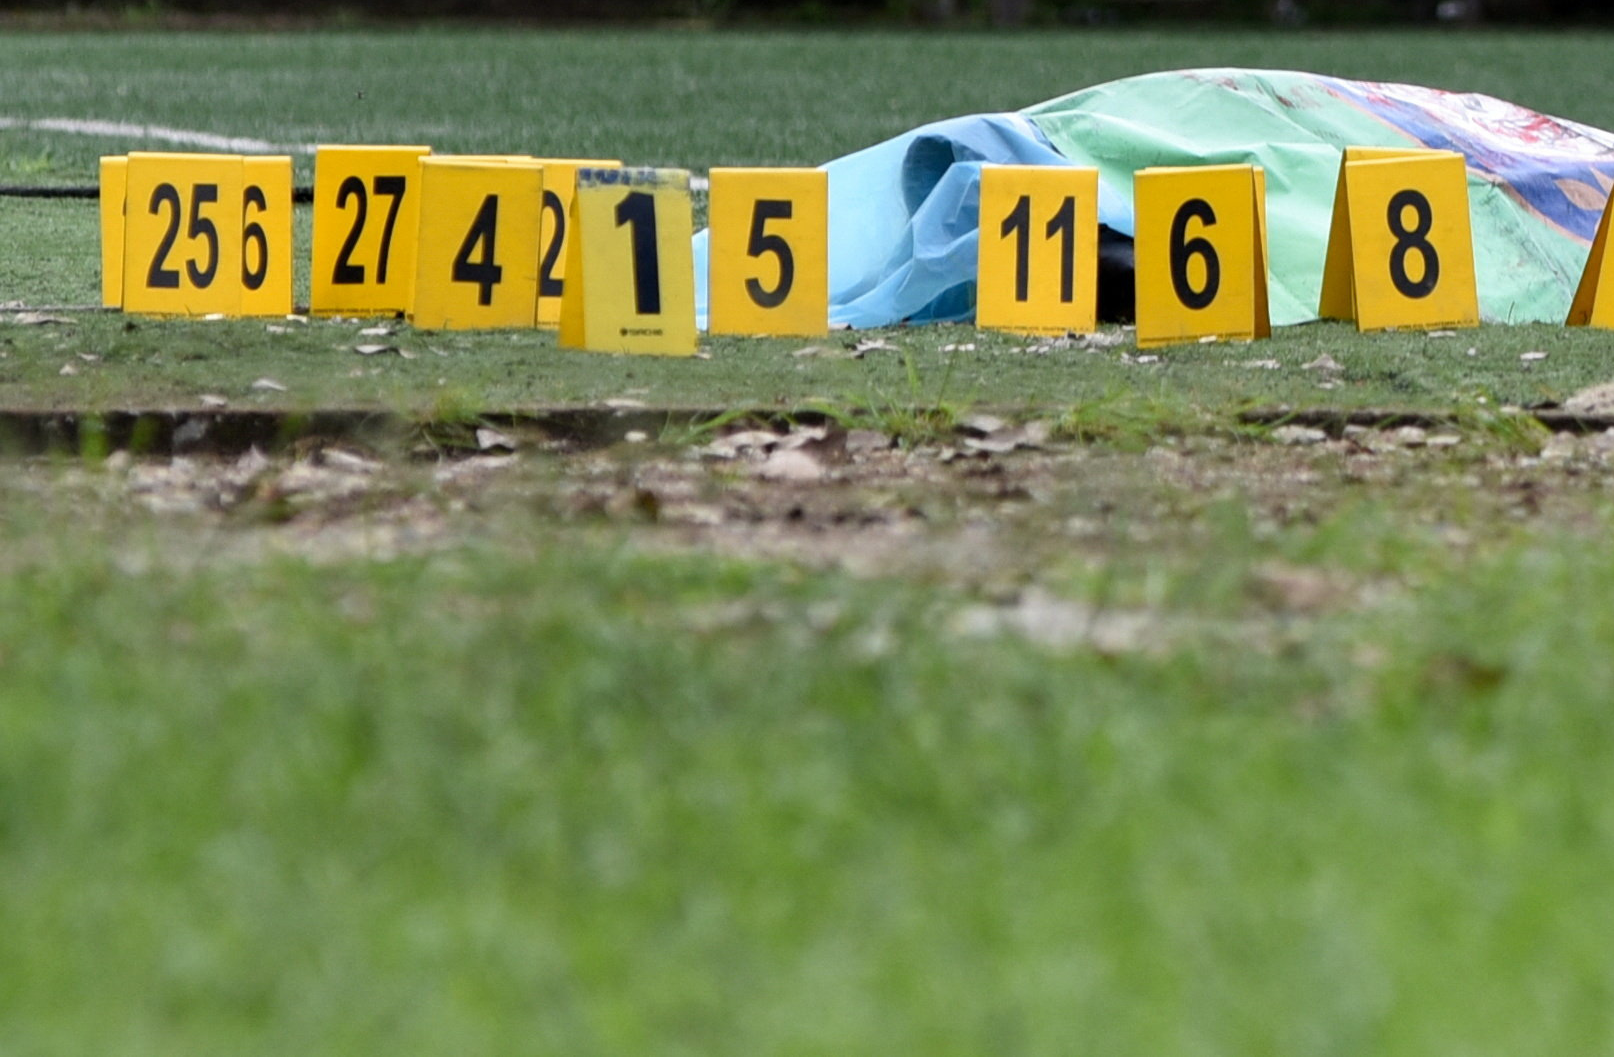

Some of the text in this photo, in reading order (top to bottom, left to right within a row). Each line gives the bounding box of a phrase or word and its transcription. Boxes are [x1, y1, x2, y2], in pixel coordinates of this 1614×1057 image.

[147, 182, 220, 290] 25
[331, 174, 407, 286] 27
[451, 193, 503, 306] 4
[614, 190, 662, 315] 1
[745, 198, 796, 309] 5
[1000, 194, 1075, 303] 11
[1168, 197, 1222, 311] 6
[1386, 188, 1441, 300] 8
